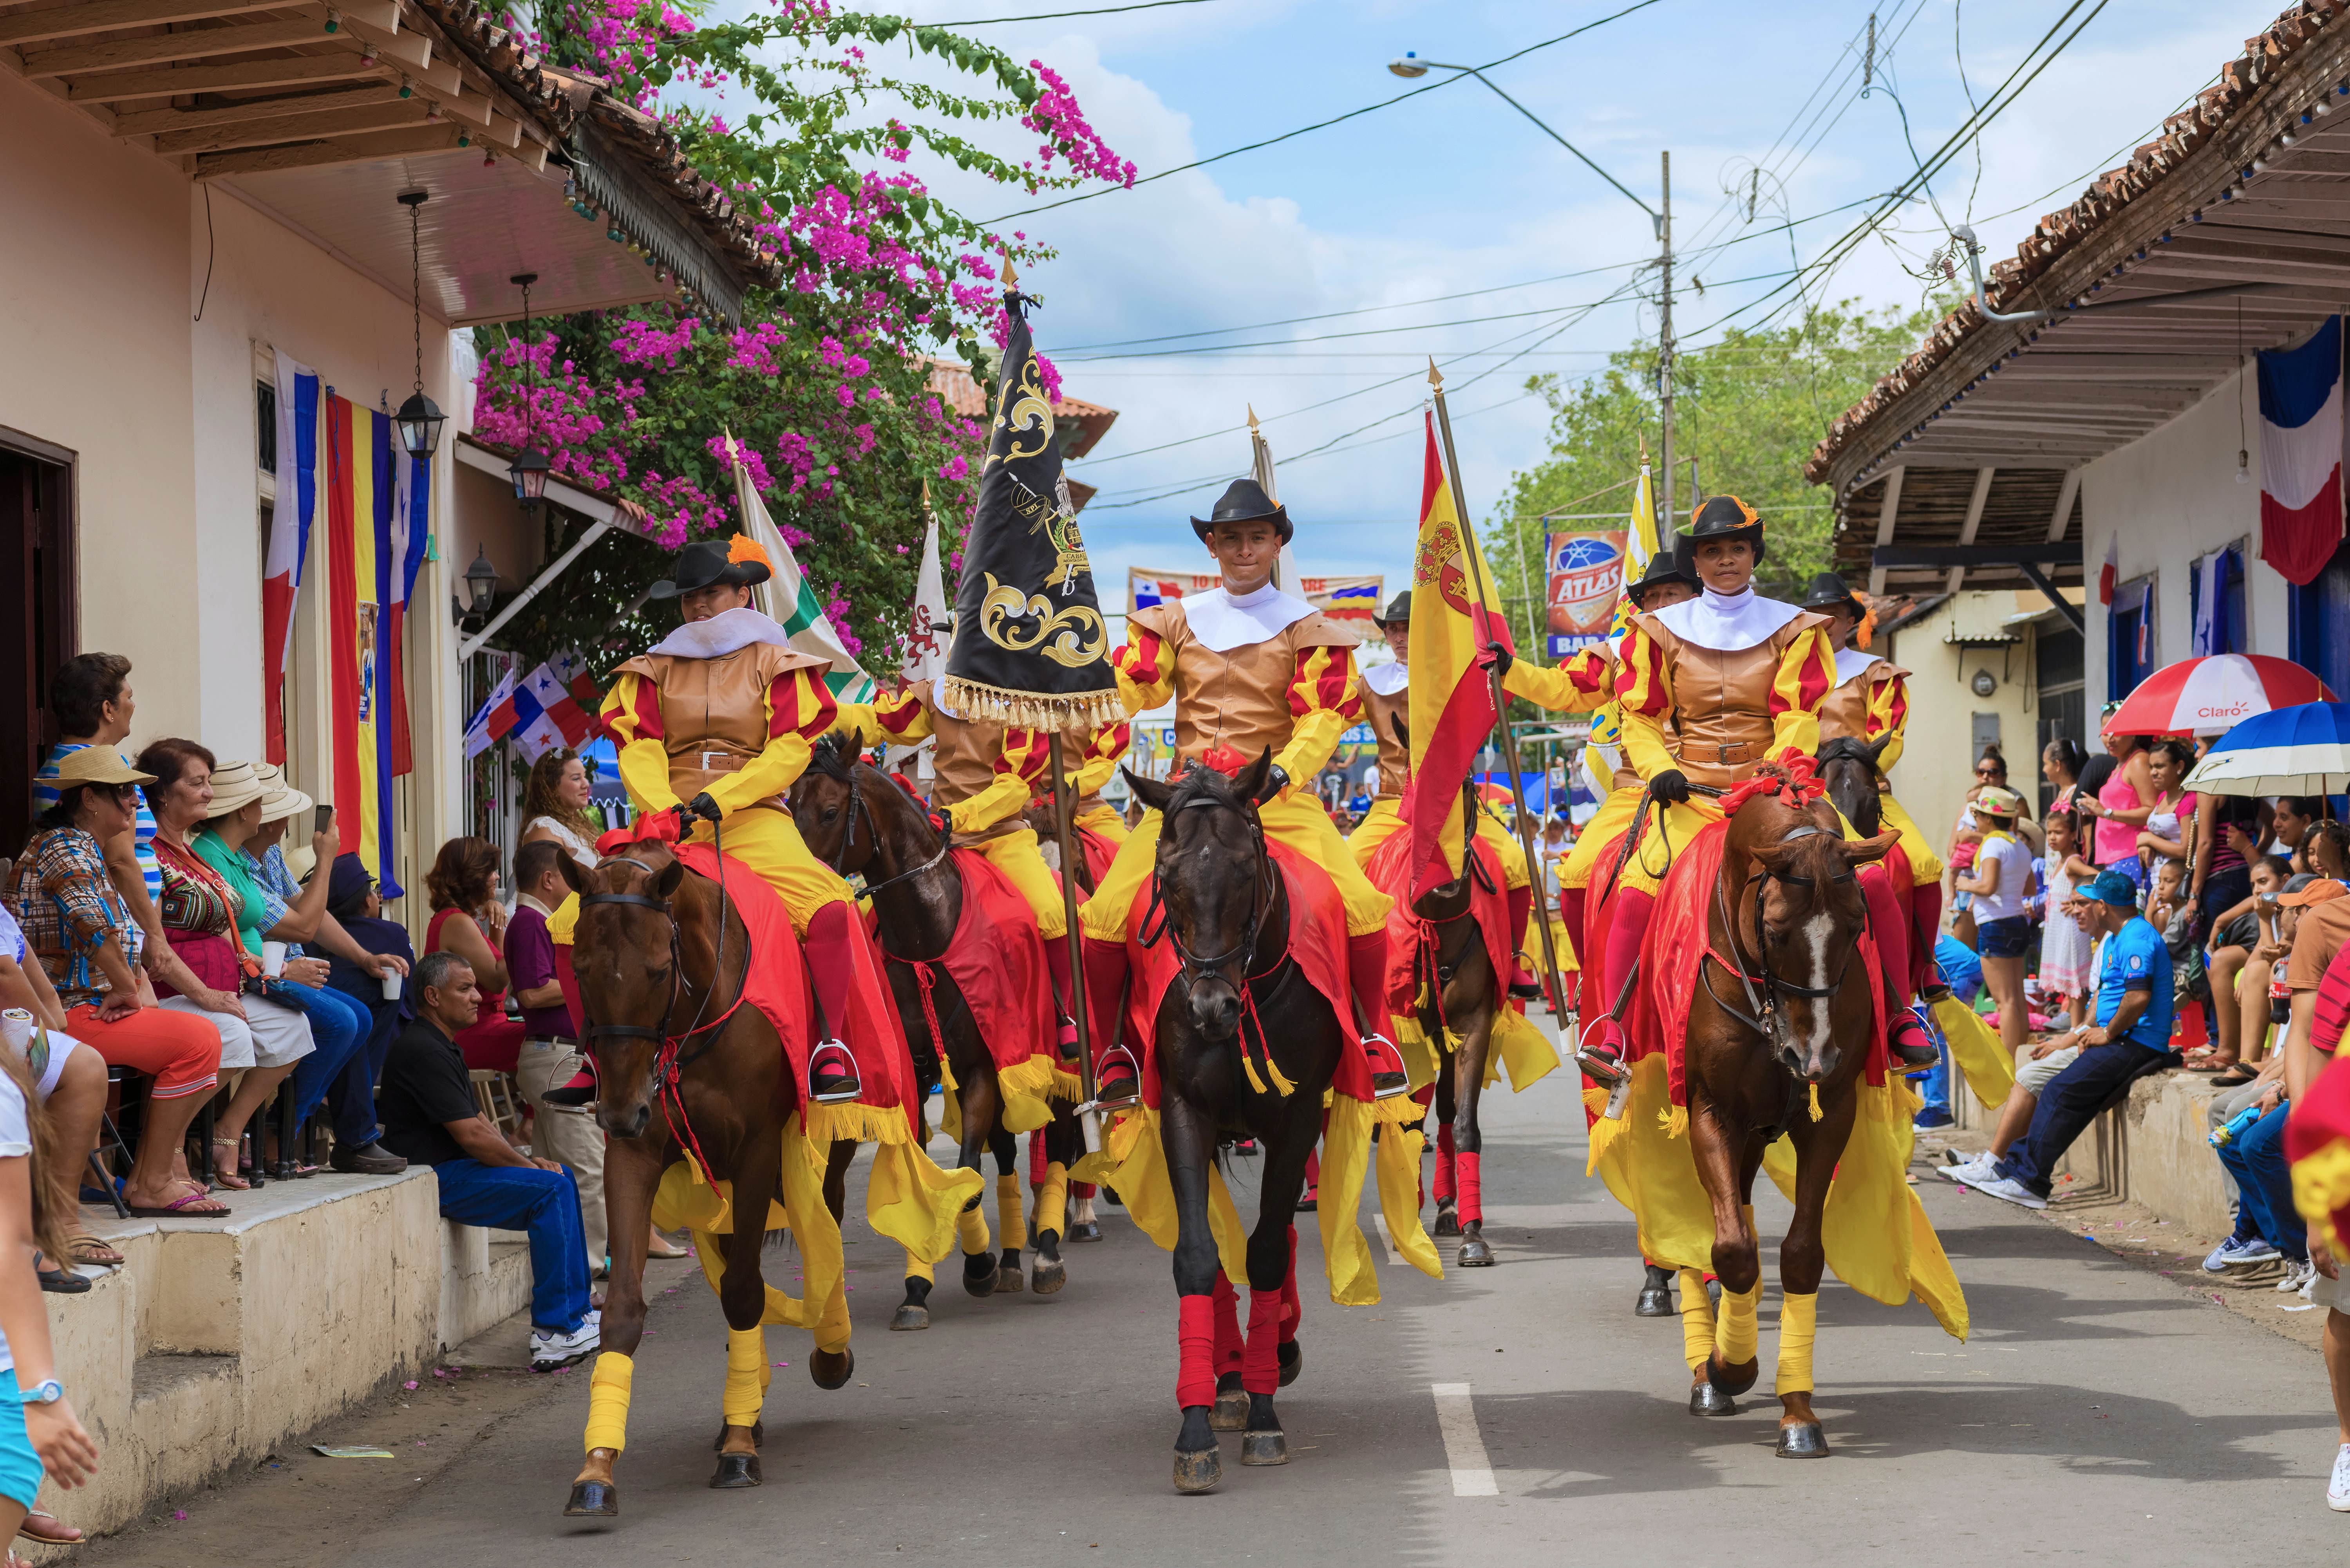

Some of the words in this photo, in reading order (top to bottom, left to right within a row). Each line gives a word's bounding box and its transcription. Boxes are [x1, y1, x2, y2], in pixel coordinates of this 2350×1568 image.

[1193, 576, 1208, 588] 10
[1556, 565, 1619, 602] ATLAS
[2198, 707, 2241, 717] Claro
[1340, 726, 1361, 742] US
